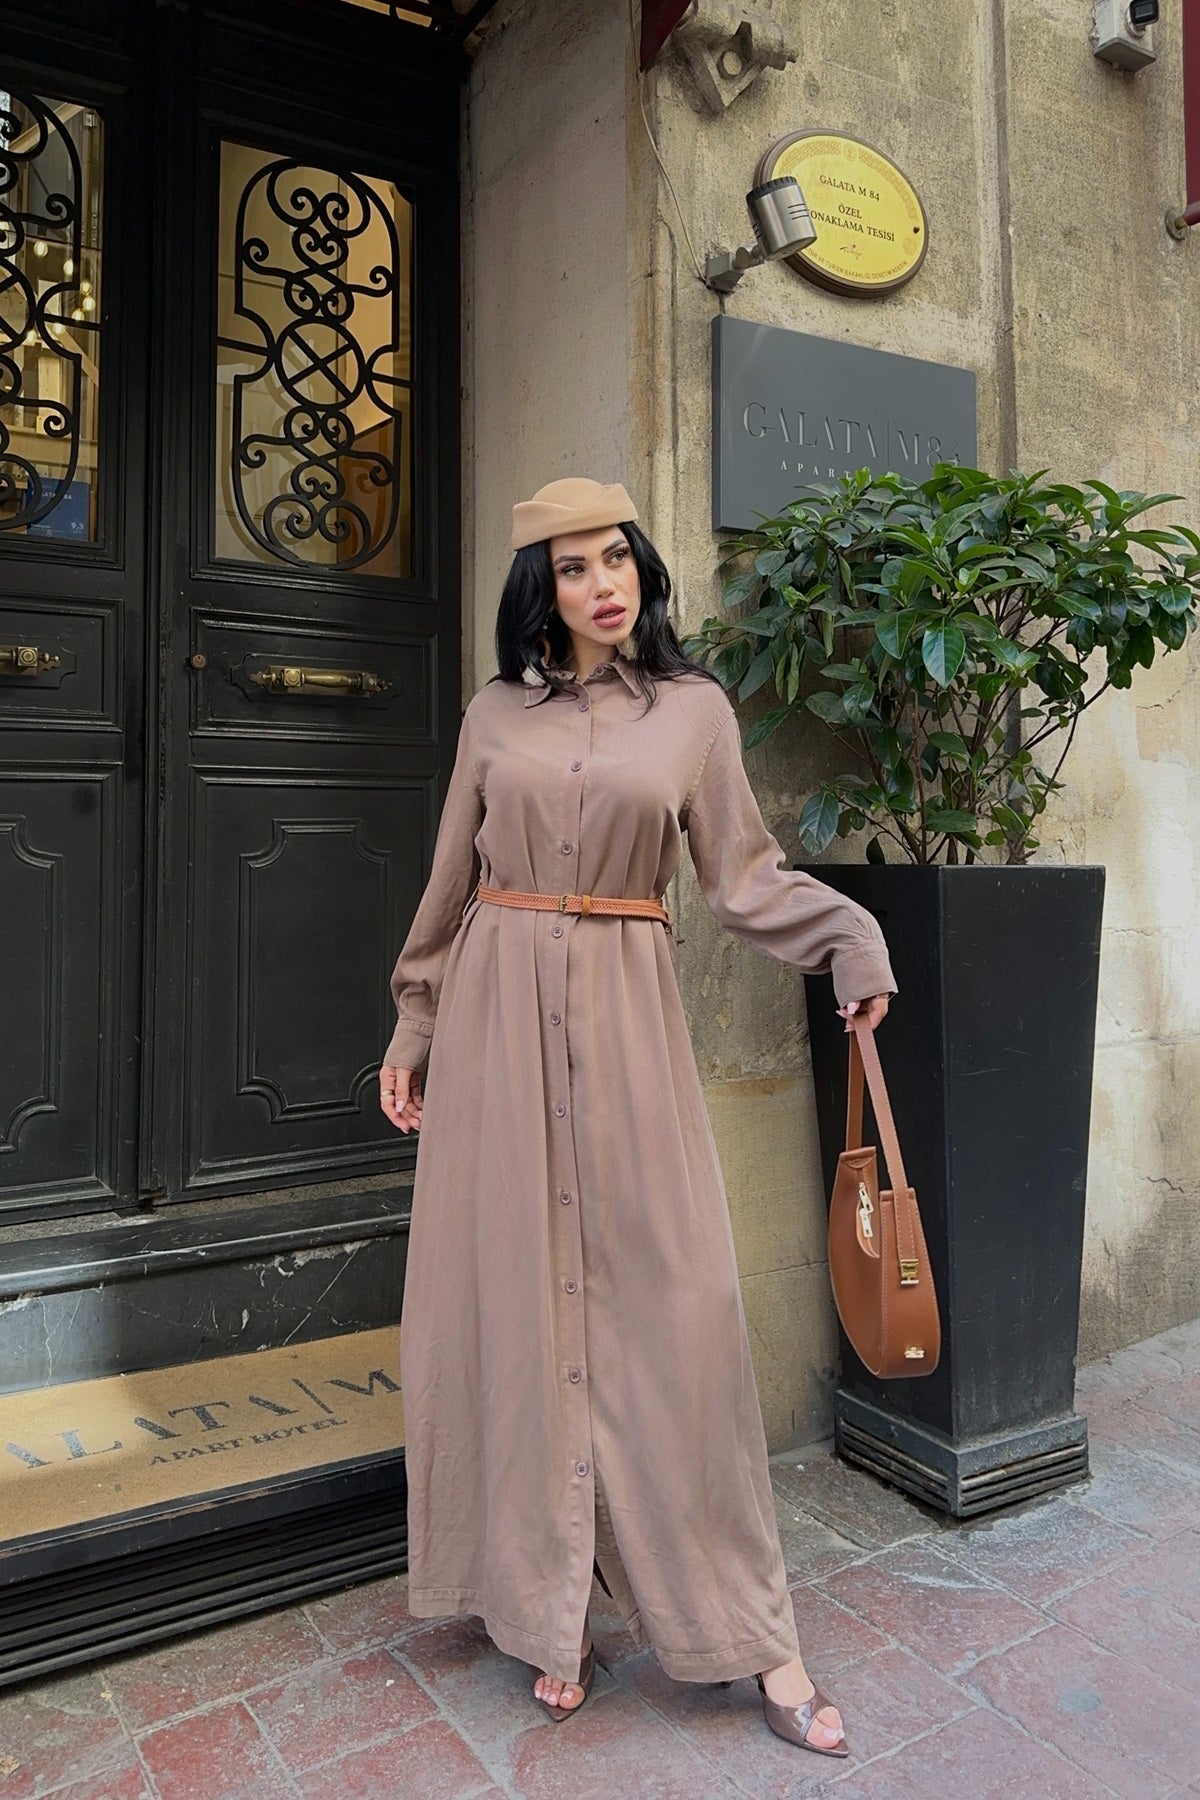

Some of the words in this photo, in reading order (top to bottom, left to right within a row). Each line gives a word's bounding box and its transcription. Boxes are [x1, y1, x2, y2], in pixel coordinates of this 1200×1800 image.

[819, 175, 856, 193] GALATA
[858, 186, 867, 197] M
[869, 190, 880, 202] 84
[838, 203, 863, 219] ÖZEL
[866, 225, 895, 242] TESİSİ
[743, 402, 879, 458] GALATA
[6, 1395, 299, 1469] ALATA
[150, 1438, 243, 1466] APART
[250, 1418, 348, 1444] HOTEL
